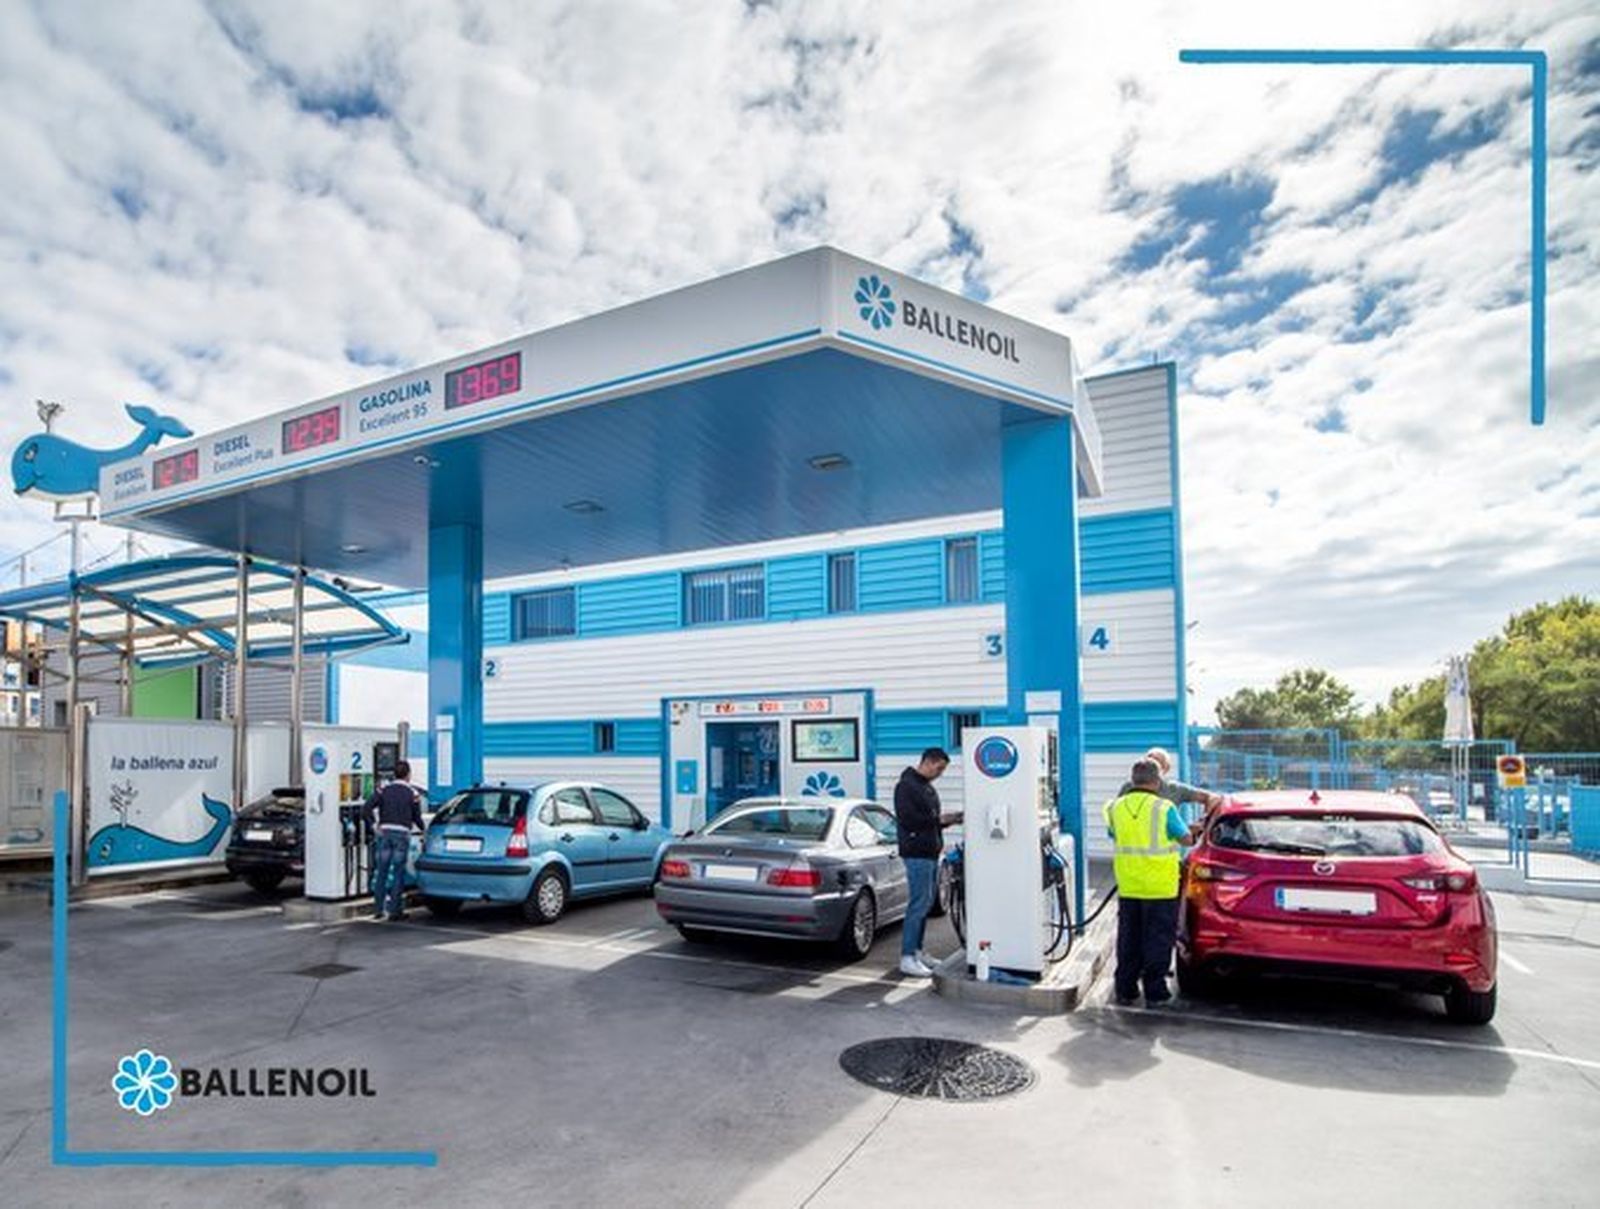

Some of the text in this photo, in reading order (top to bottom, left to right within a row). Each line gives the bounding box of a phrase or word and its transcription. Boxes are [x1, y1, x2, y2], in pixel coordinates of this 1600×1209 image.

[902, 300, 1020, 364] BALLENOIL
[359, 380, 432, 413] GASOLINA
[360, 402, 428, 433] Excellent 95
[214, 434, 250, 456] DIESEL
[985, 634, 1003, 656] 3
[1088, 627, 1109, 650] 4
[485, 660, 496, 677] 2
[110, 755, 218, 770] la ballena azul
[351, 751, 362, 770] 2
